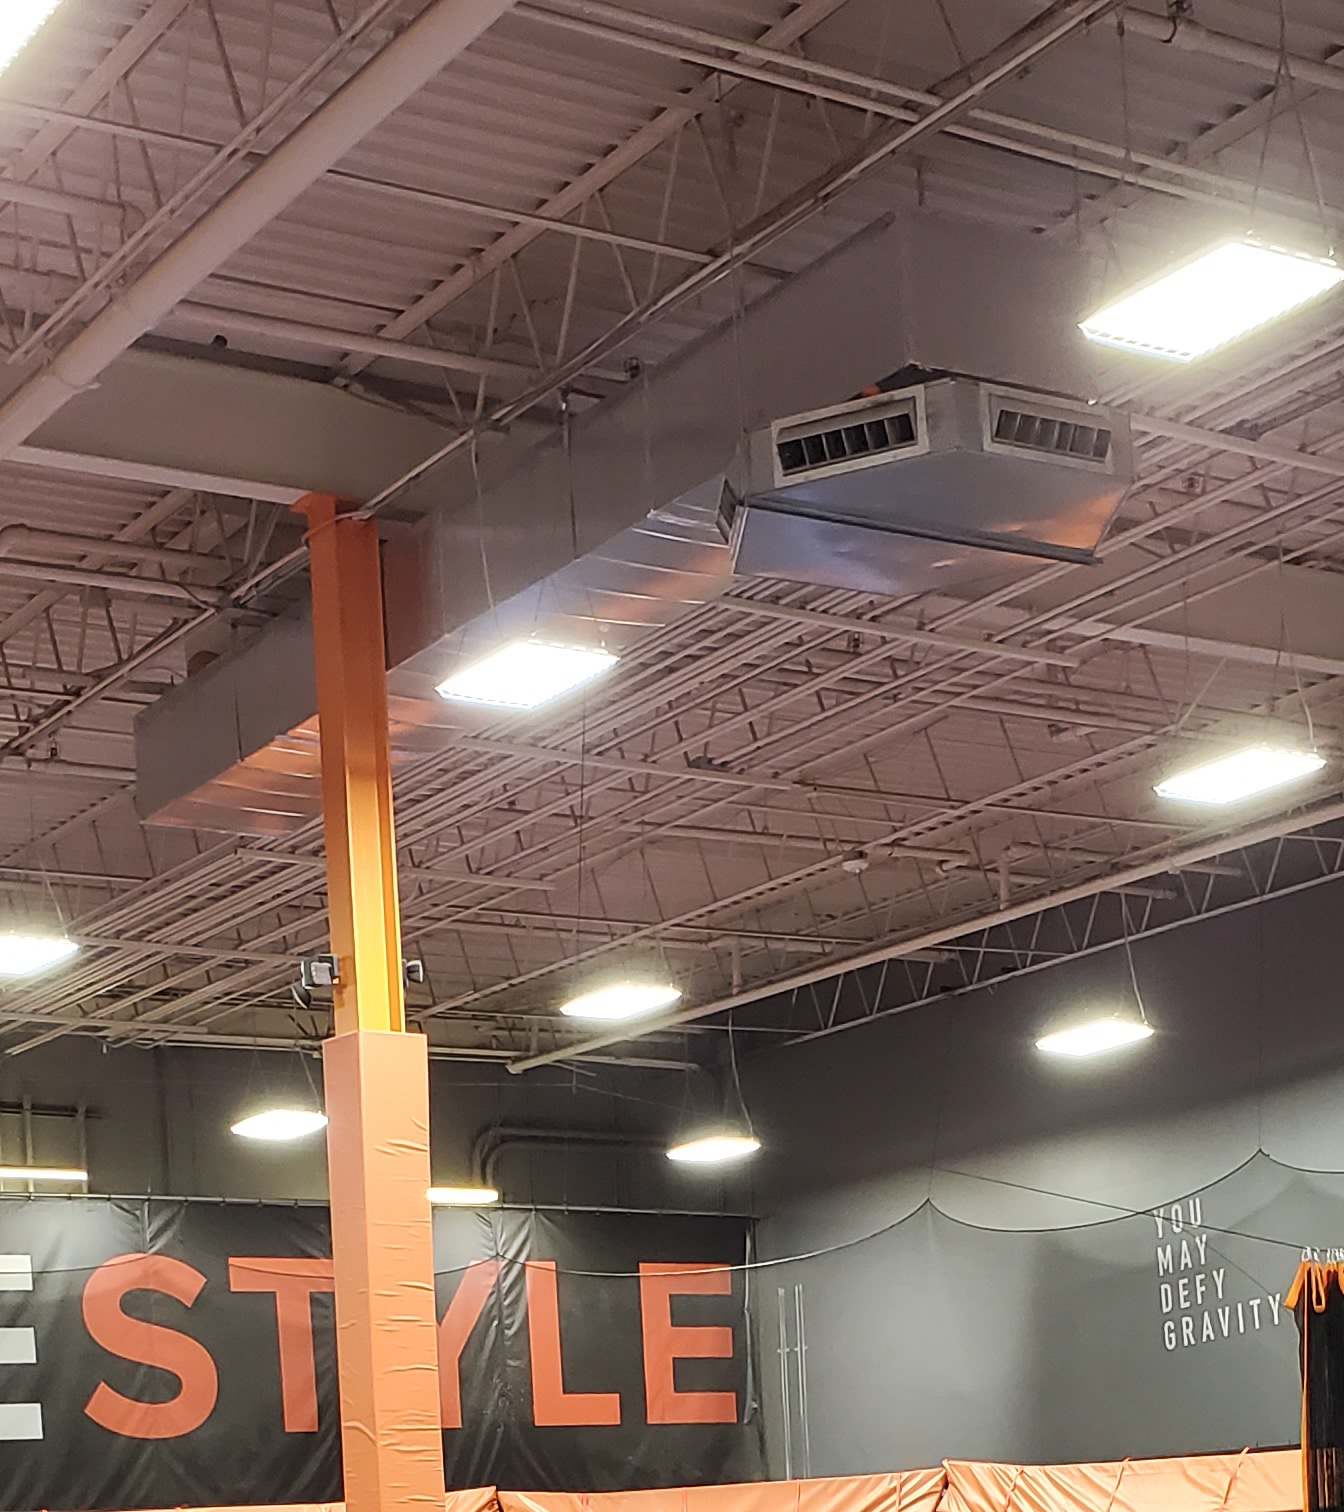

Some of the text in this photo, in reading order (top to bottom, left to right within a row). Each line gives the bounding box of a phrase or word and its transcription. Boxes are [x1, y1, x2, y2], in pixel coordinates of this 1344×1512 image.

[1152, 1197, 1203, 1239] YOU
[1156, 1233, 1207, 1277] MAY
[1160, 1268, 1225, 1314] DEFY
[1163, 1293, 1281, 1351] GRAVITY
